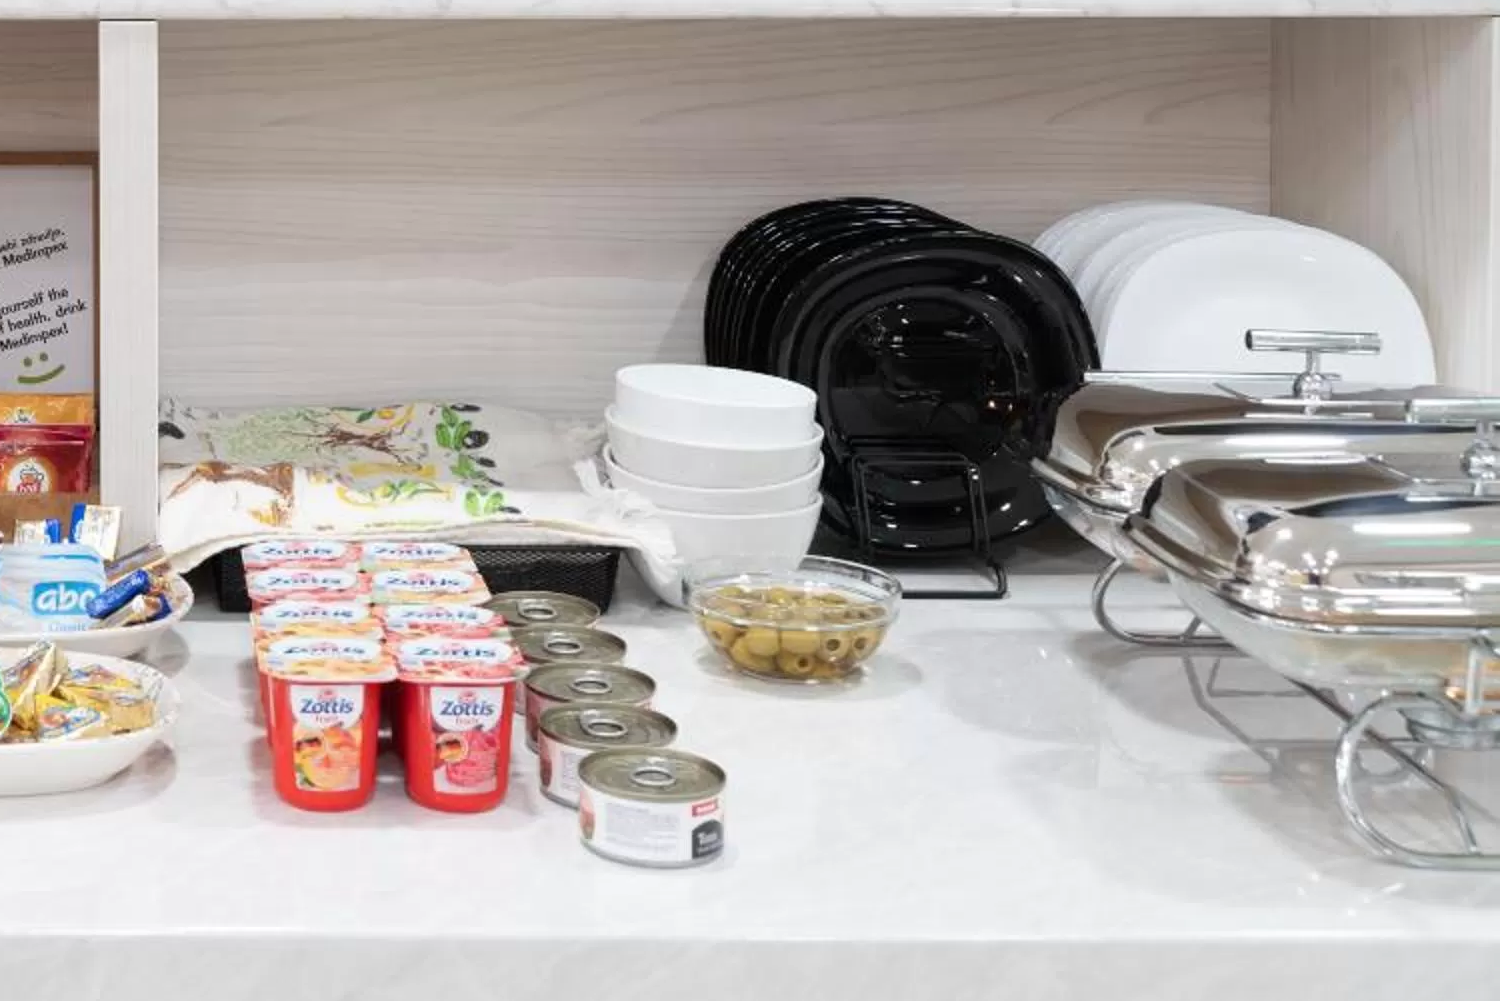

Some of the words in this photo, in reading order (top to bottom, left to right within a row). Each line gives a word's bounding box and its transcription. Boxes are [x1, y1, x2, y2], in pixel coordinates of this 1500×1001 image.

[47, 287, 69, 302] the
[55, 298, 88, 318] drink
[36, 583, 97, 612] abc
[300, 698, 354, 714] Zottis
[440, 700, 495, 716] Zottis
